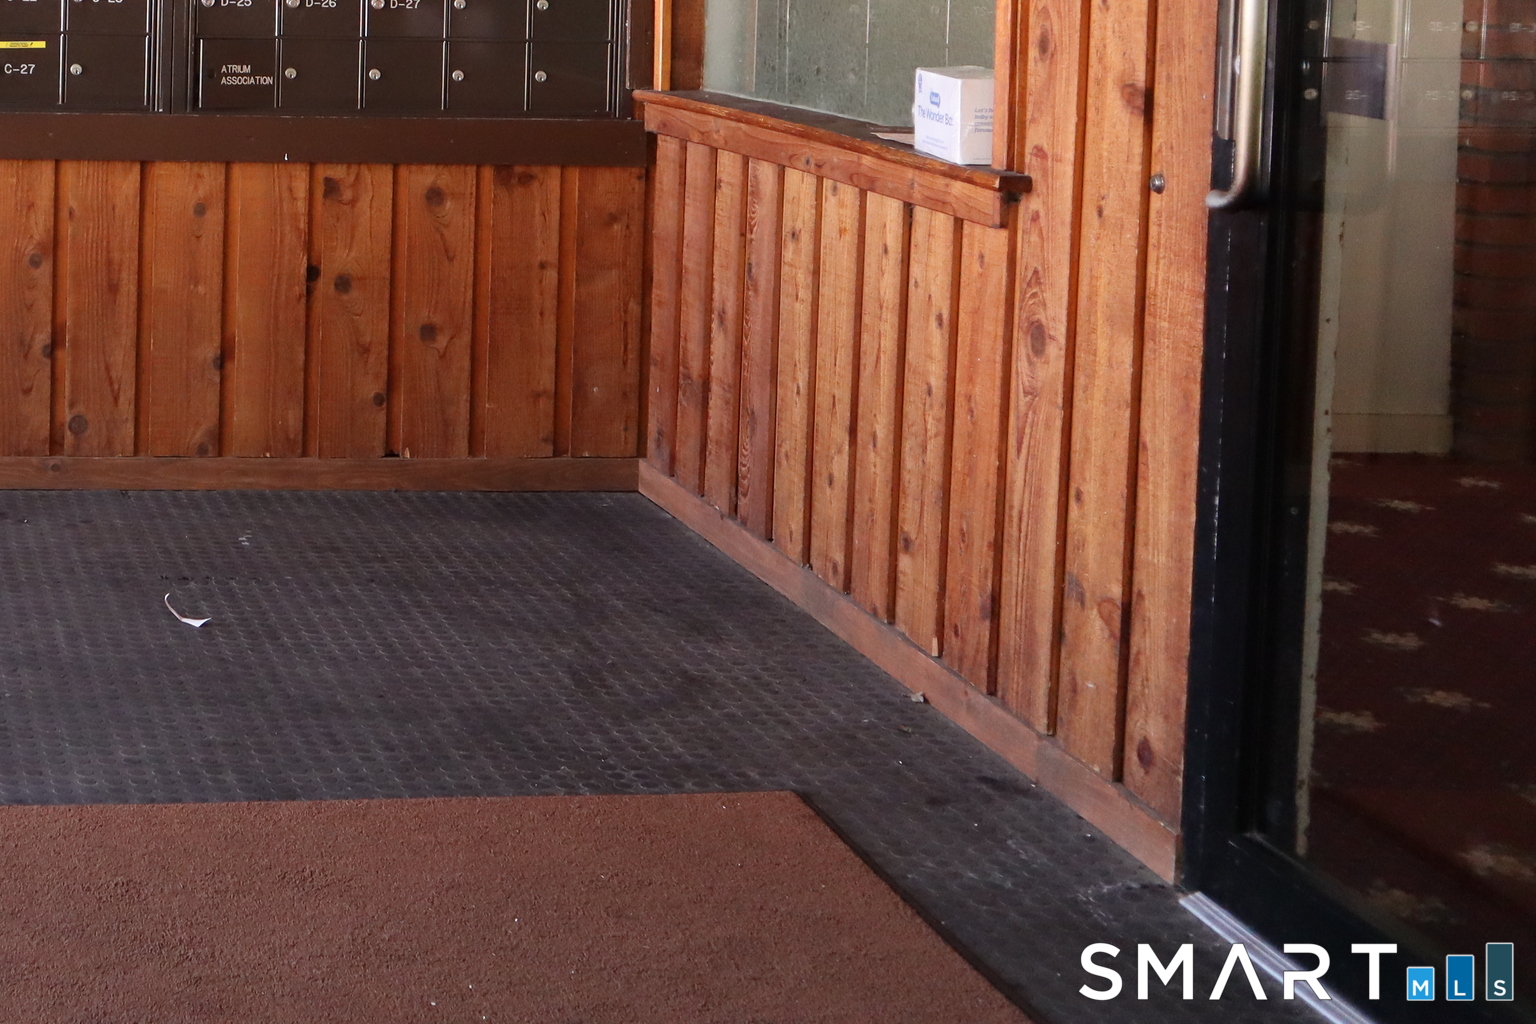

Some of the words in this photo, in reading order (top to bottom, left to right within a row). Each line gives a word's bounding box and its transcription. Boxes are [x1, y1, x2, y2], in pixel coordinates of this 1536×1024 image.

[391, 0, 420, 8] D-27
[5, 64, 35, 74] C-27
[221, 65, 251, 74] ATRIUM
[221, 76, 273, 85] ASSOCIATION
[918, 105, 926, 118] The
[926, 108, 945, 124] Wonder
[945, 113, 954, 127] Bo
